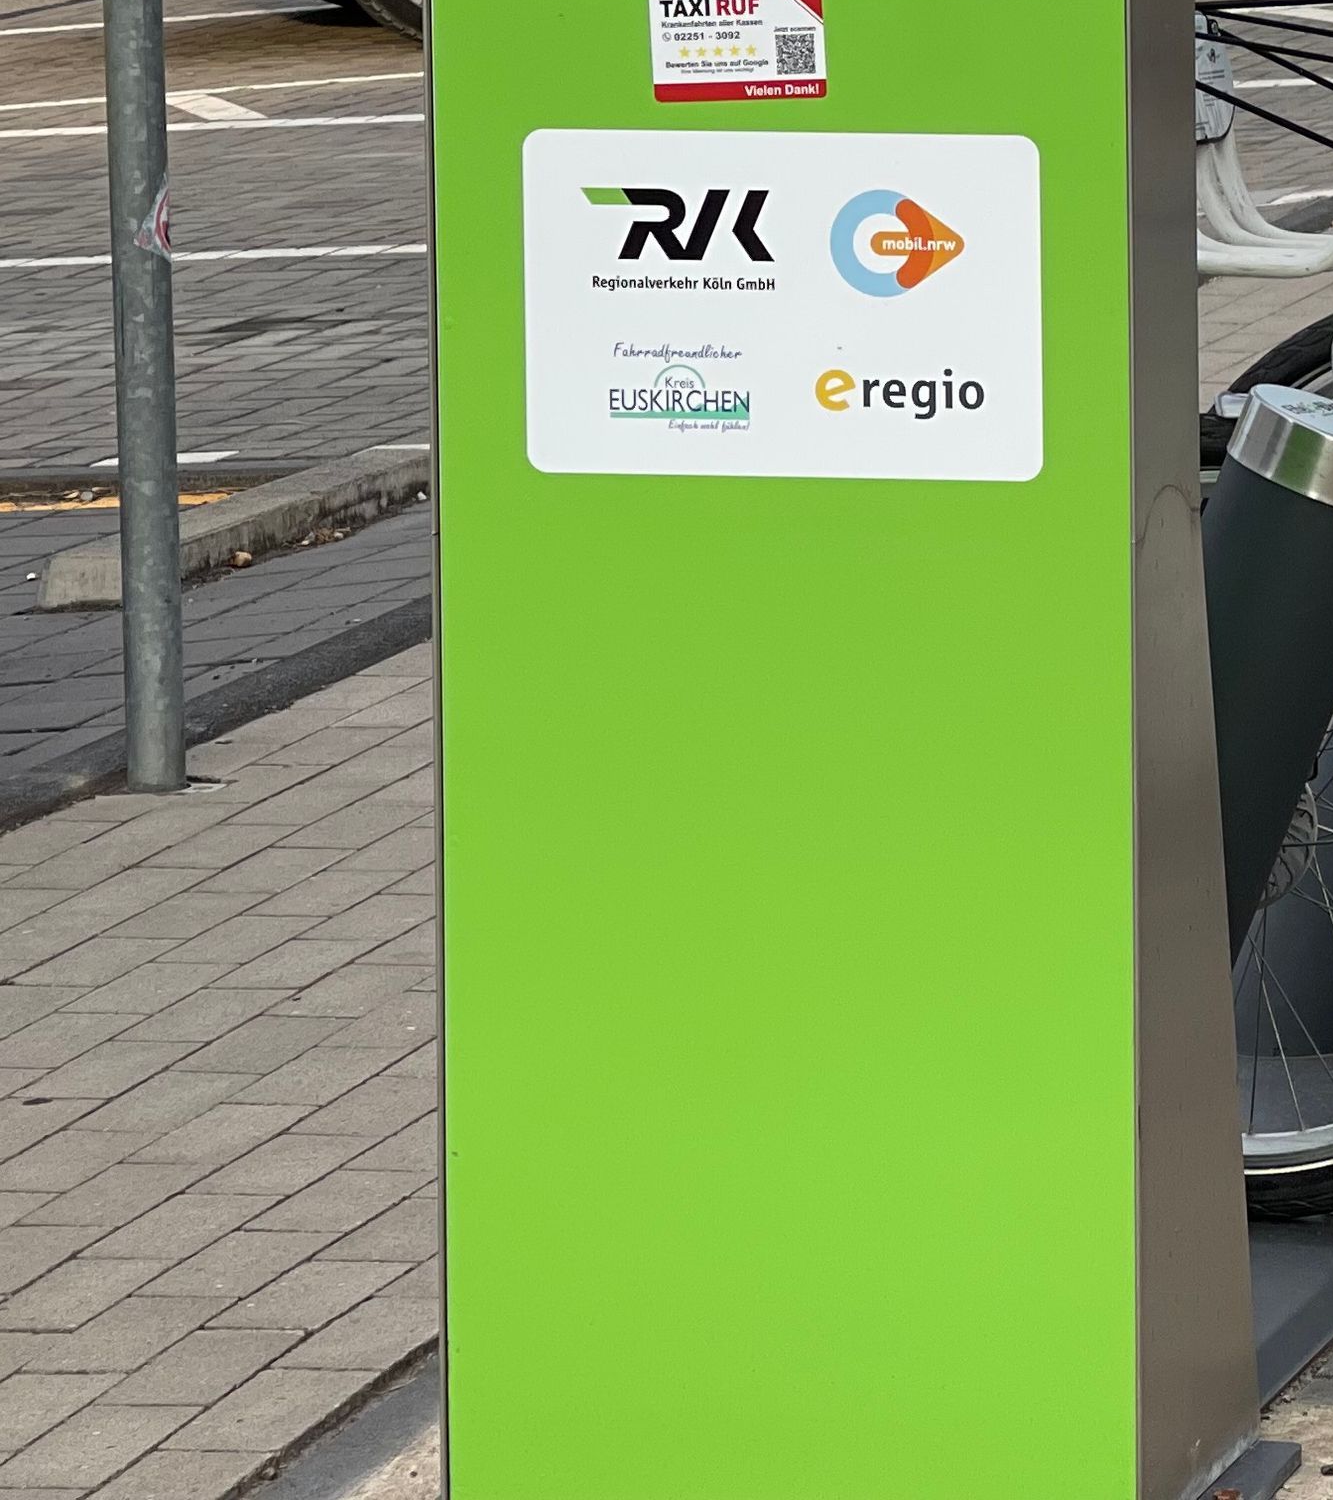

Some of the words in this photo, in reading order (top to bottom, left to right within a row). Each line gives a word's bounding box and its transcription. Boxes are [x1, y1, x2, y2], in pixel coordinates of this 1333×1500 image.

[660, 0, 710, 17] TAXI
[661, 19, 717, 28] Krankenfahrten
[719, 19, 734, 27] aller
[674, 33, 704, 41] 02251
[716, 32, 740, 40] 3092
[743, 59, 769, 67] Google
[745, 85, 782, 97] Vielen
[785, 84, 819, 95] Dank!
[882, 236, 956, 252] mobil.nrw
[592, 276, 698, 291] Regionalverkehr
[703, 276, 732, 291] Köln
[736, 278, 775, 291] GmbH
[614, 342, 742, 363] Fahrradfreundlicher
[665, 377, 694, 388] Kreis
[610, 389, 749, 412] EUSKIRCHEN
